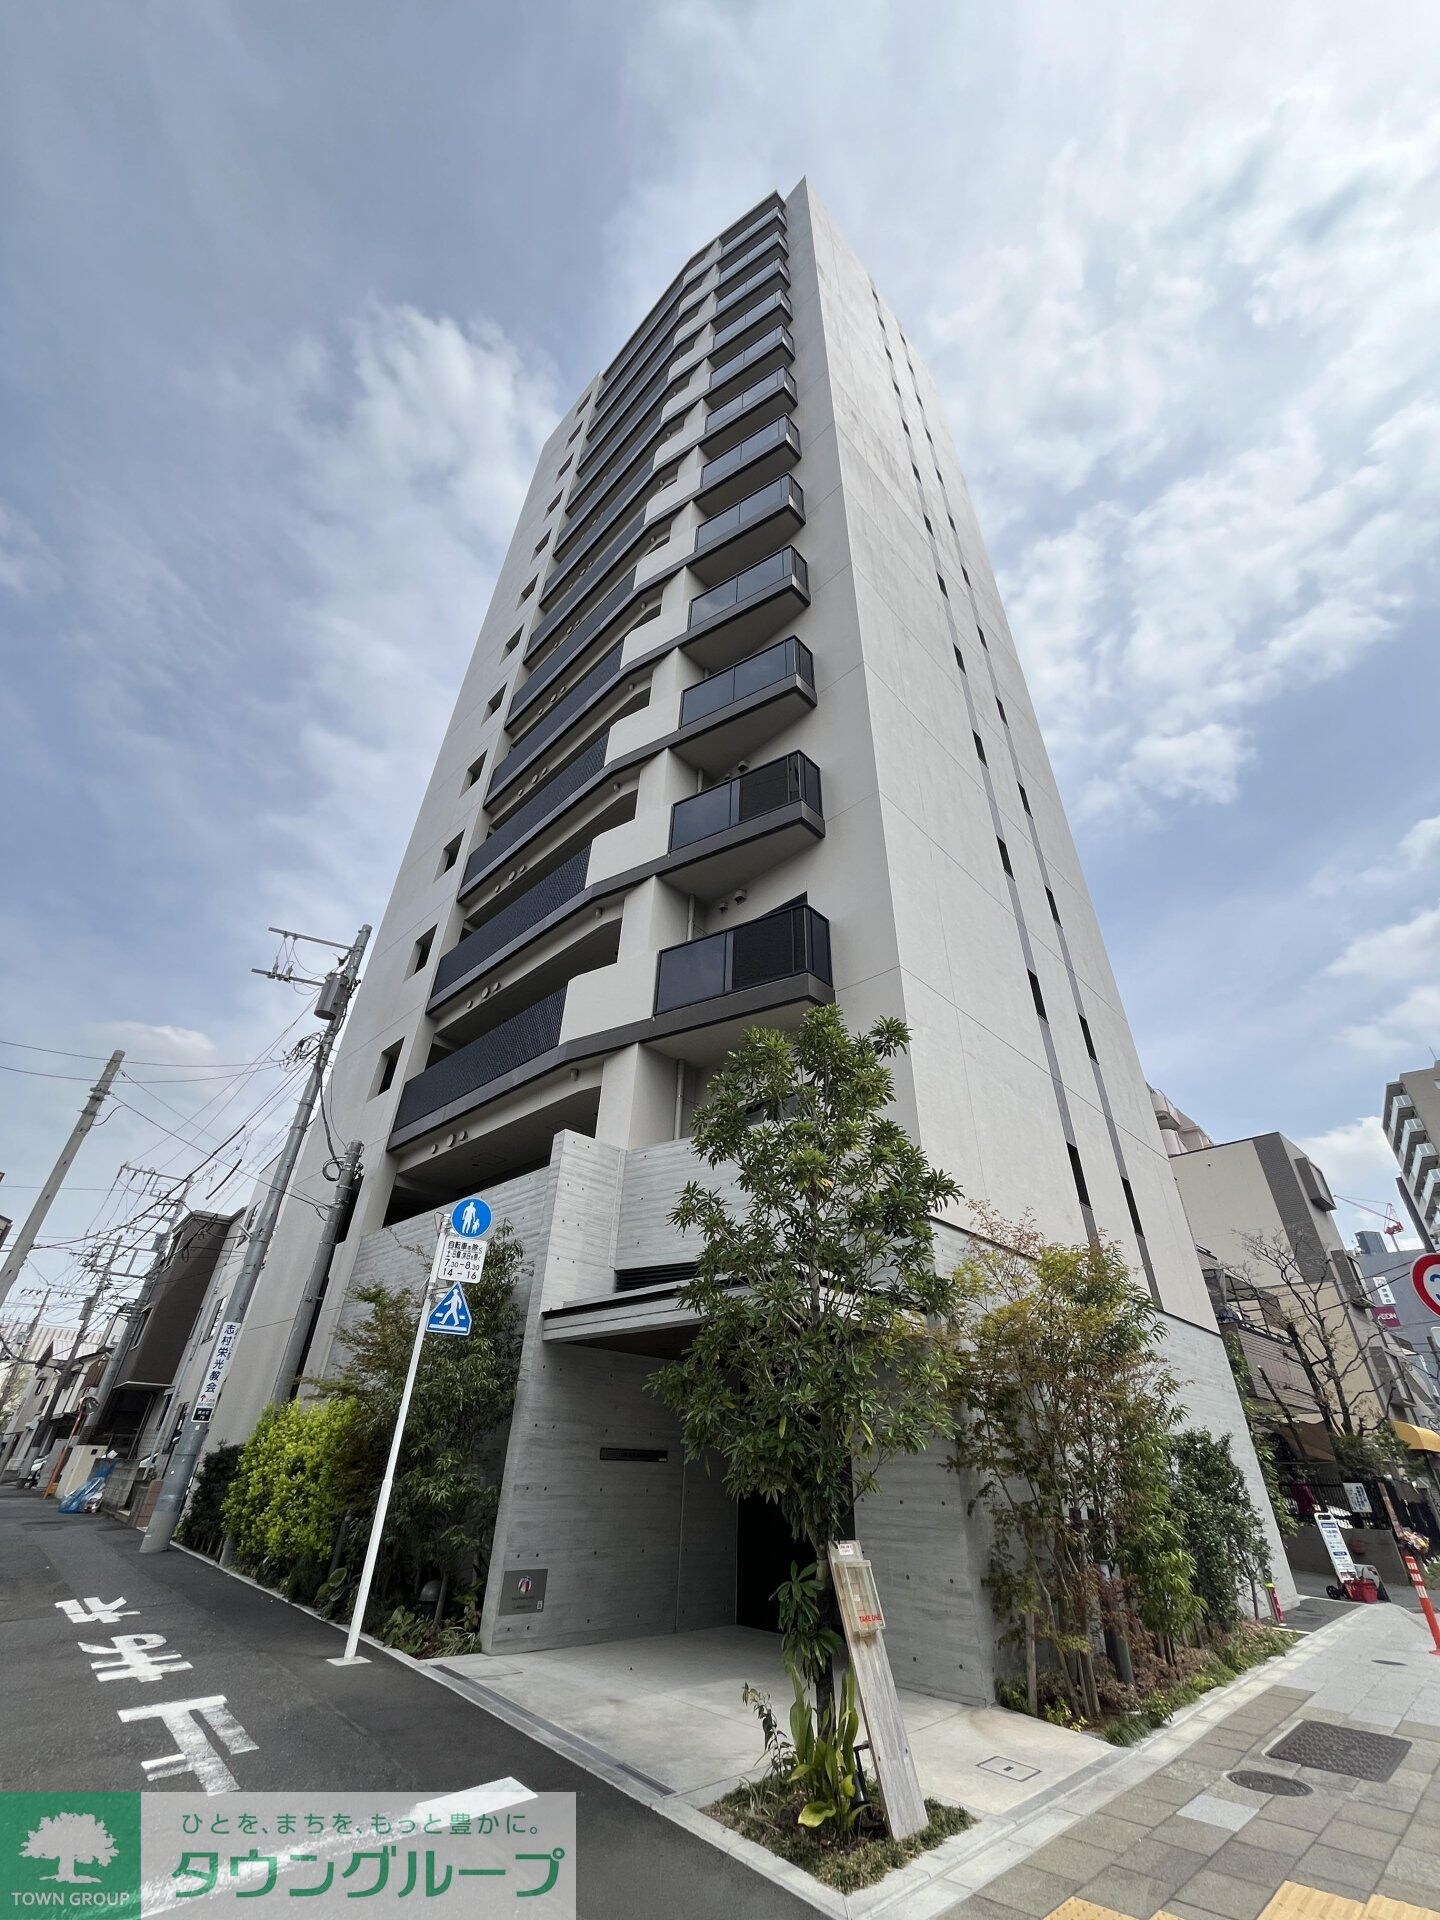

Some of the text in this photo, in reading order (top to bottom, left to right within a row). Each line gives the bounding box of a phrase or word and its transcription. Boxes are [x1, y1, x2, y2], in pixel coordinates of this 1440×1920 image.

[448, 1240, 482, 1253] 自転車を除く
[205, 1324, 236, 1393] 志村栄光教会
